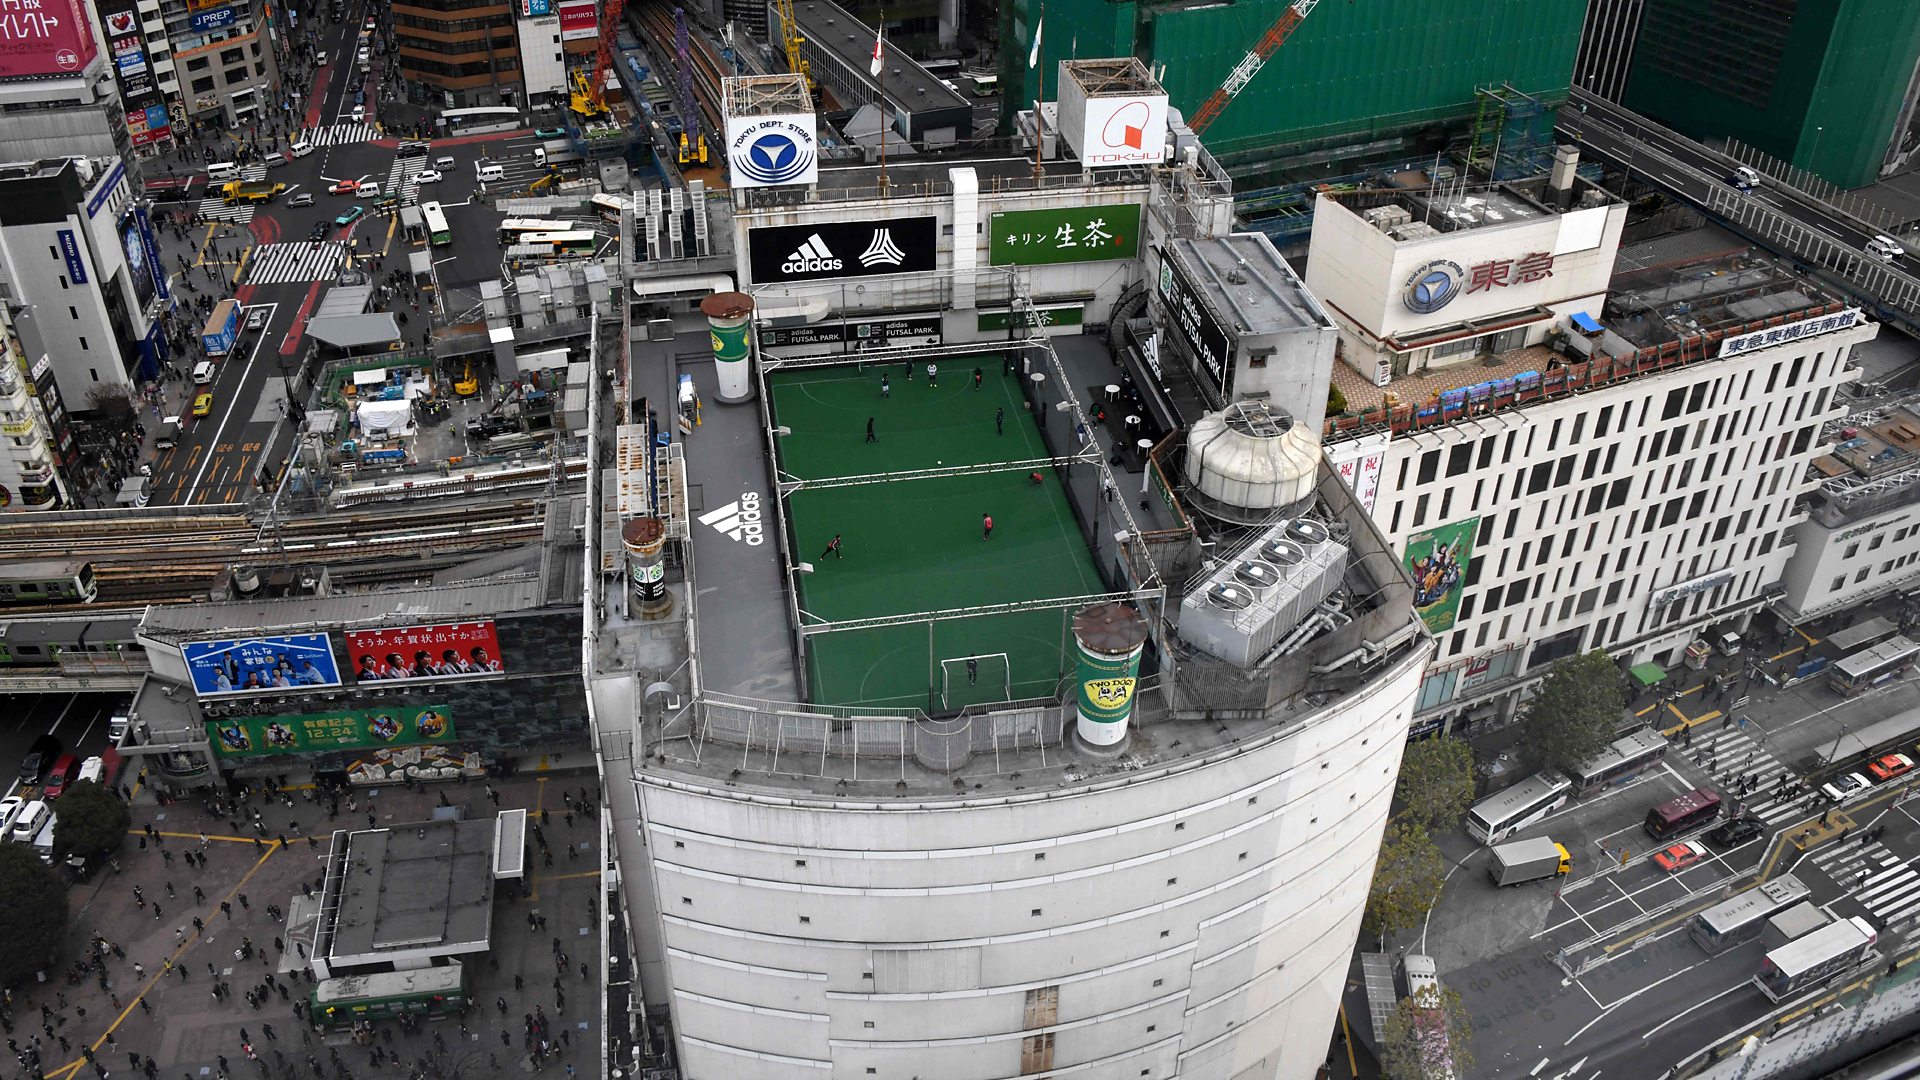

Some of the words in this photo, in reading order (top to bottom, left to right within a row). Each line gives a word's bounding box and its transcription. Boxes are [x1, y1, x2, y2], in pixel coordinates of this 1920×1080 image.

[195, 17, 202, 26] J
[203, 10, 231, 21] PREP
[563, 11, 594, 20] 三井のリハウス
[58, 54, 77, 64] 生薬
[734, 126, 756, 148] TOKYU
[788, 124, 812, 143] STORE
[1088, 152, 1160, 163] TOKYU
[1006, 233, 1047, 246] キリン
[1054, 218, 1113, 248] 生茶
[781, 258, 843, 274] adidas
[1465, 251, 1556, 295] 東急
[1182, 292, 1201, 327] adidas
[791, 335, 819, 344] FUTSAL
[886, 328, 913, 337] FUTSAL
[1725, 311, 1856, 355] 東急東横店南館
[1180, 308, 1203, 354] FUTSAL
[1203, 343, 1222, 383] PARK.
[741, 491, 764, 546] adidas
[356, 632, 470, 648] そうか、年賀状出すか
[241, 647, 273, 656] みんな
[1088, 681, 1111, 690] TWO
[1112, 679, 1134, 687] DOGS
[306, 727, 353, 738] 12.24
